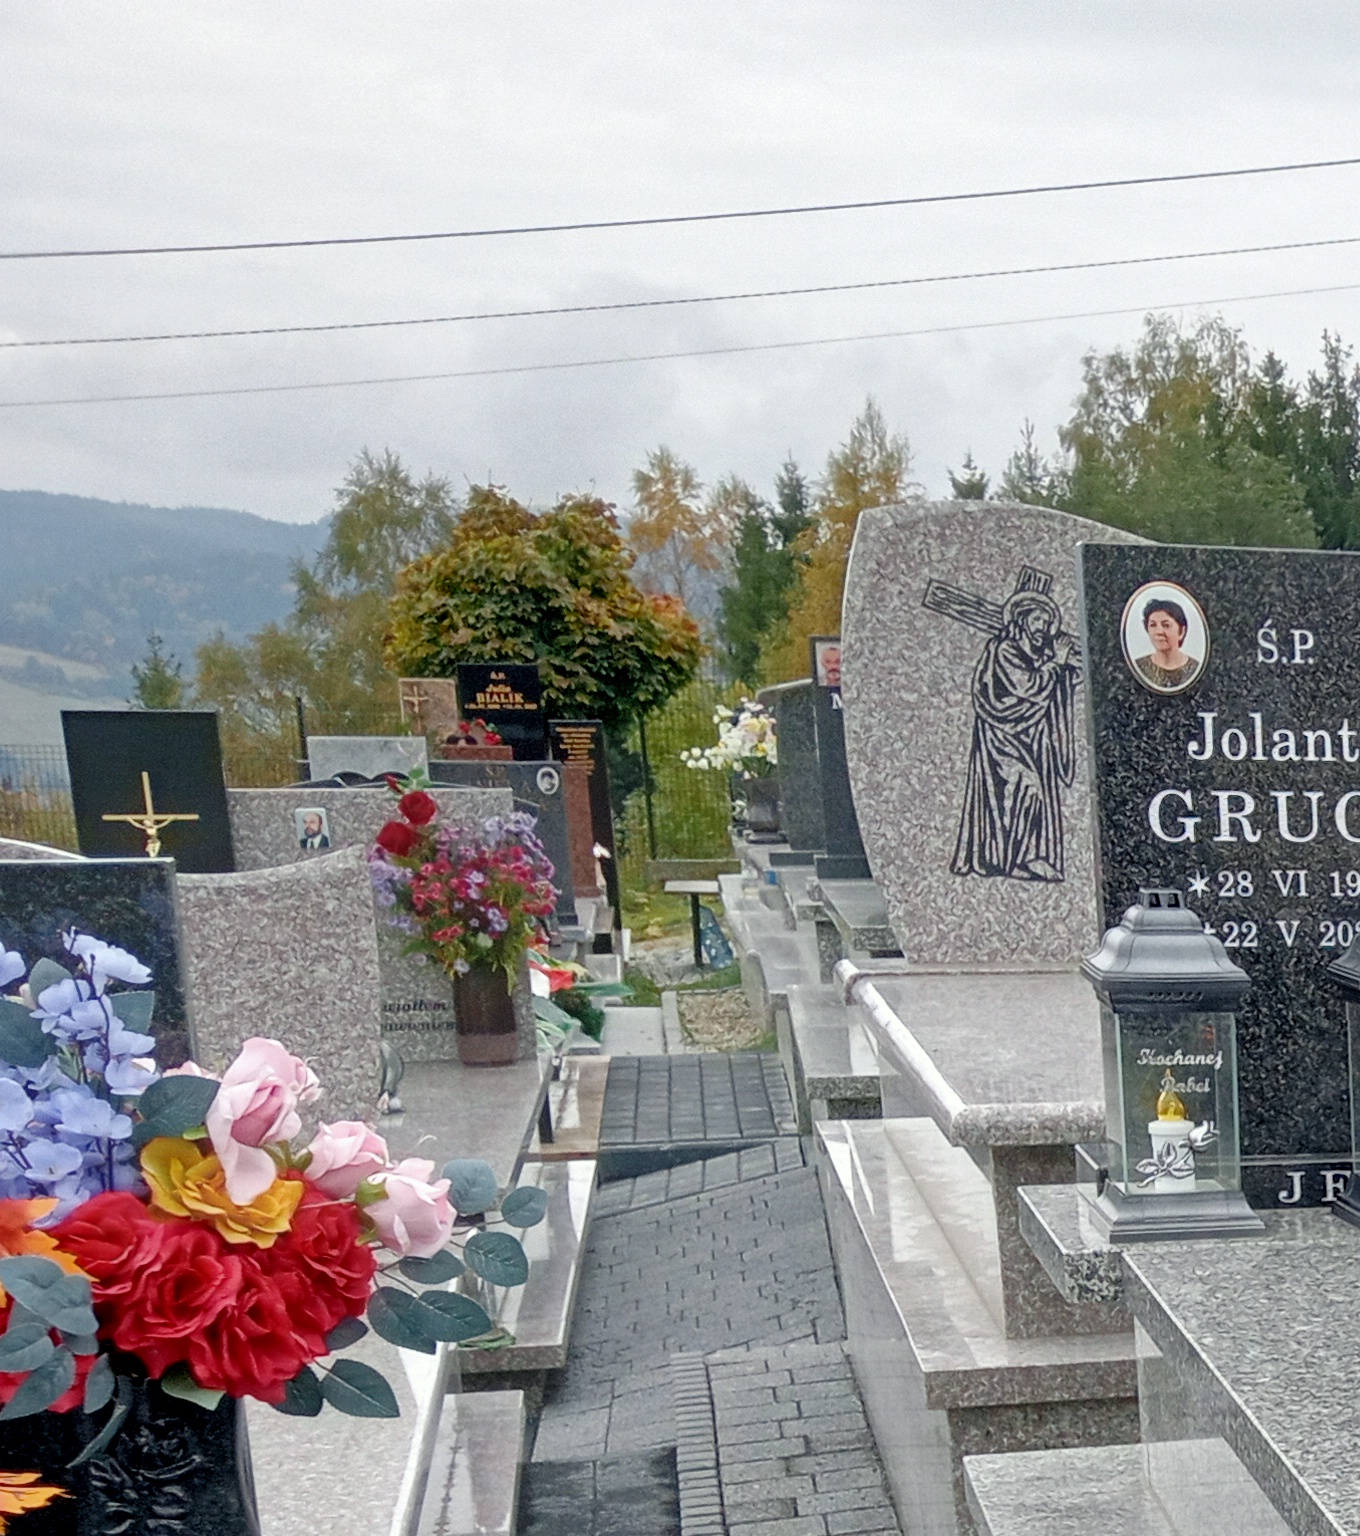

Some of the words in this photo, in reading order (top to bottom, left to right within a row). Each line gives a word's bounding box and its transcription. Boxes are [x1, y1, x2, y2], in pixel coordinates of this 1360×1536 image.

[1256, 619, 1316, 665] Ś.P.
[1217, 869, 1254, 898] 28
[1271, 869, 1310, 897] VI
[1222, 920, 1259, 948] 22
[1275, 919, 1302, 948] V
[1136, 1047, 1224, 1070] Kochanej
